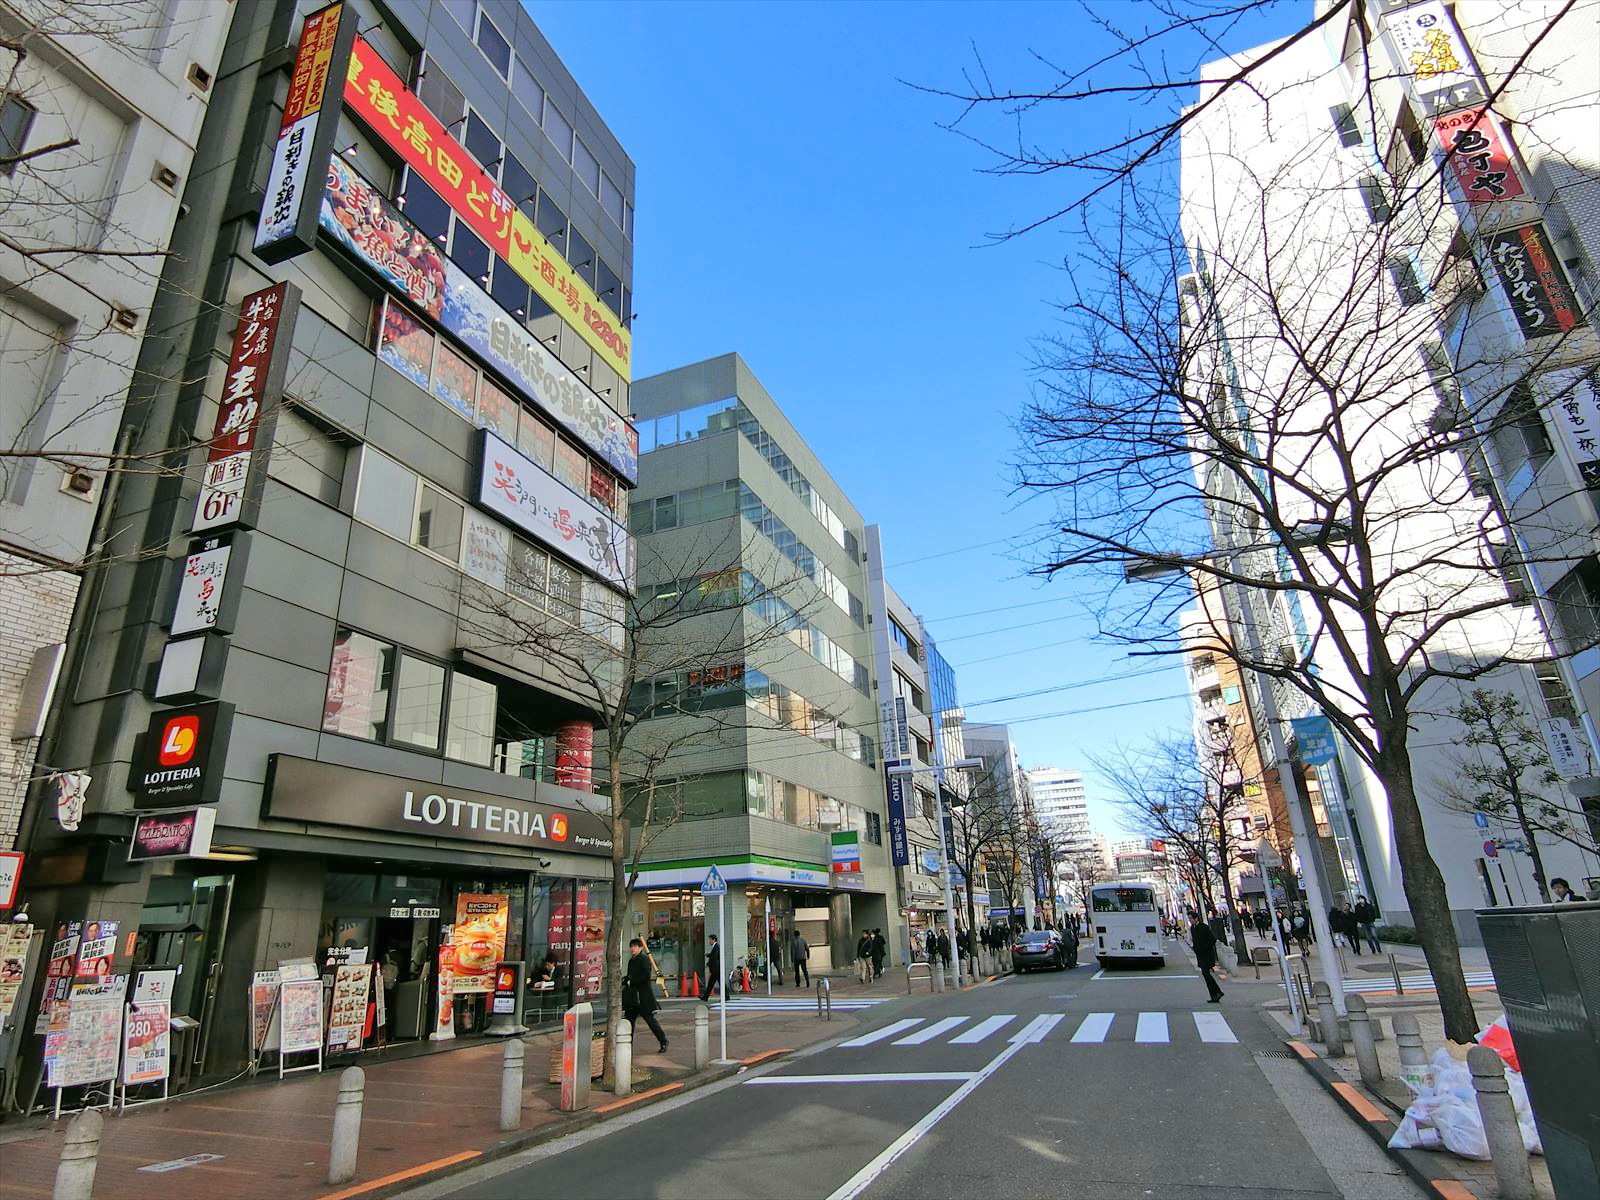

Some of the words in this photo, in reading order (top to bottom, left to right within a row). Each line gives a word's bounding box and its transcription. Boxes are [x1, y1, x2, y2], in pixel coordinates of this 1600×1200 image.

[273, 127, 305, 225] 目利きの銀次
[491, 186, 512, 214] 5F
[533, 251, 581, 314] 酒場
[238, 296, 264, 363] 牛タン
[625, 429, 639, 447] 4F
[203, 490, 239, 522] 6F
[144, 767, 201, 785] LOTTERIA
[403, 791, 547, 839] LOTTERIA
[832, 847, 858, 856] FamilyMart
[81, 948, 105, 960] 演説会
[84, 939, 106, 952] 自民党
[128, 1020, 151, 1038] 280
